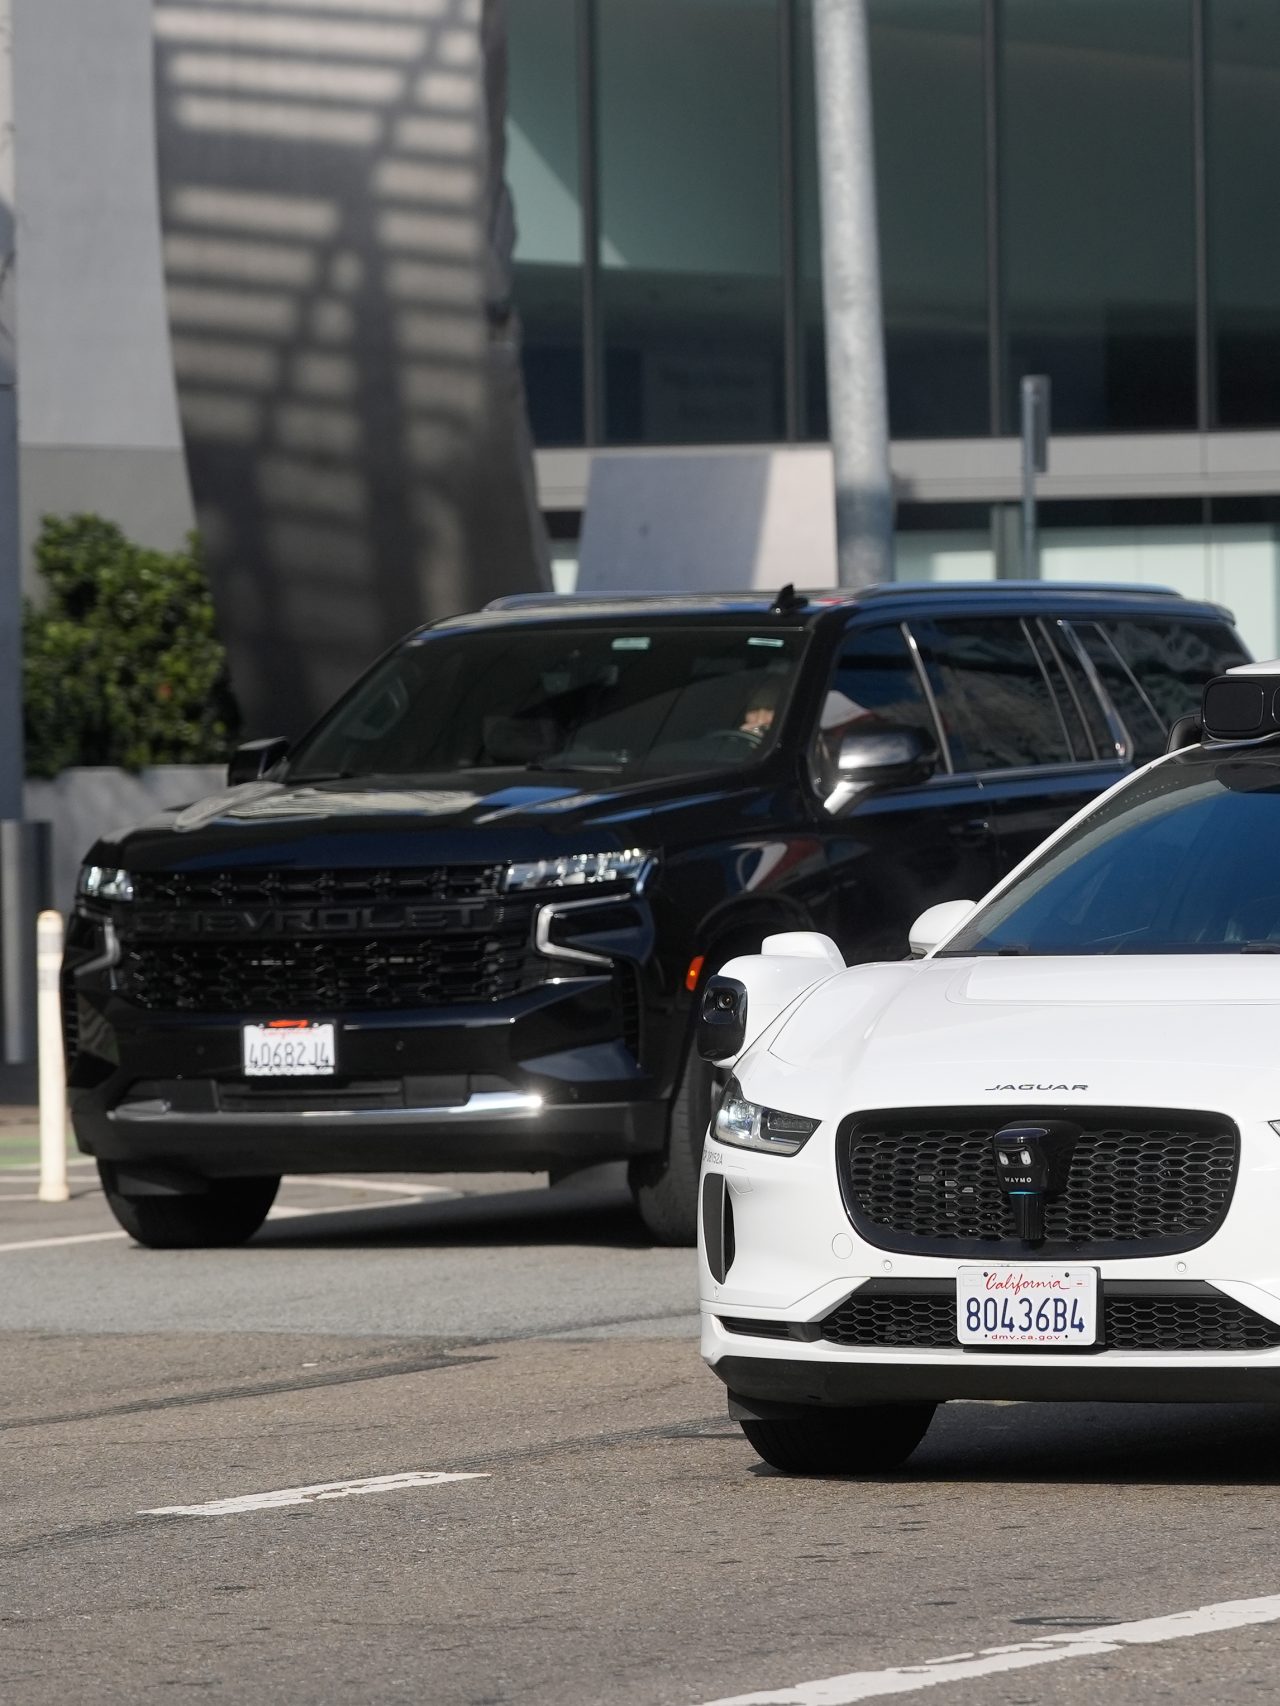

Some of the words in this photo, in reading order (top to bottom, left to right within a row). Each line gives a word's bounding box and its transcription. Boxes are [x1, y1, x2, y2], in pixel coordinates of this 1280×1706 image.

[134, 903, 487, 933] CHEVROLET
[249, 1042, 329, 1068] 40682J4
[985, 1272, 1070, 1295] California
[966, 1297, 1085, 1332] 80436B4
